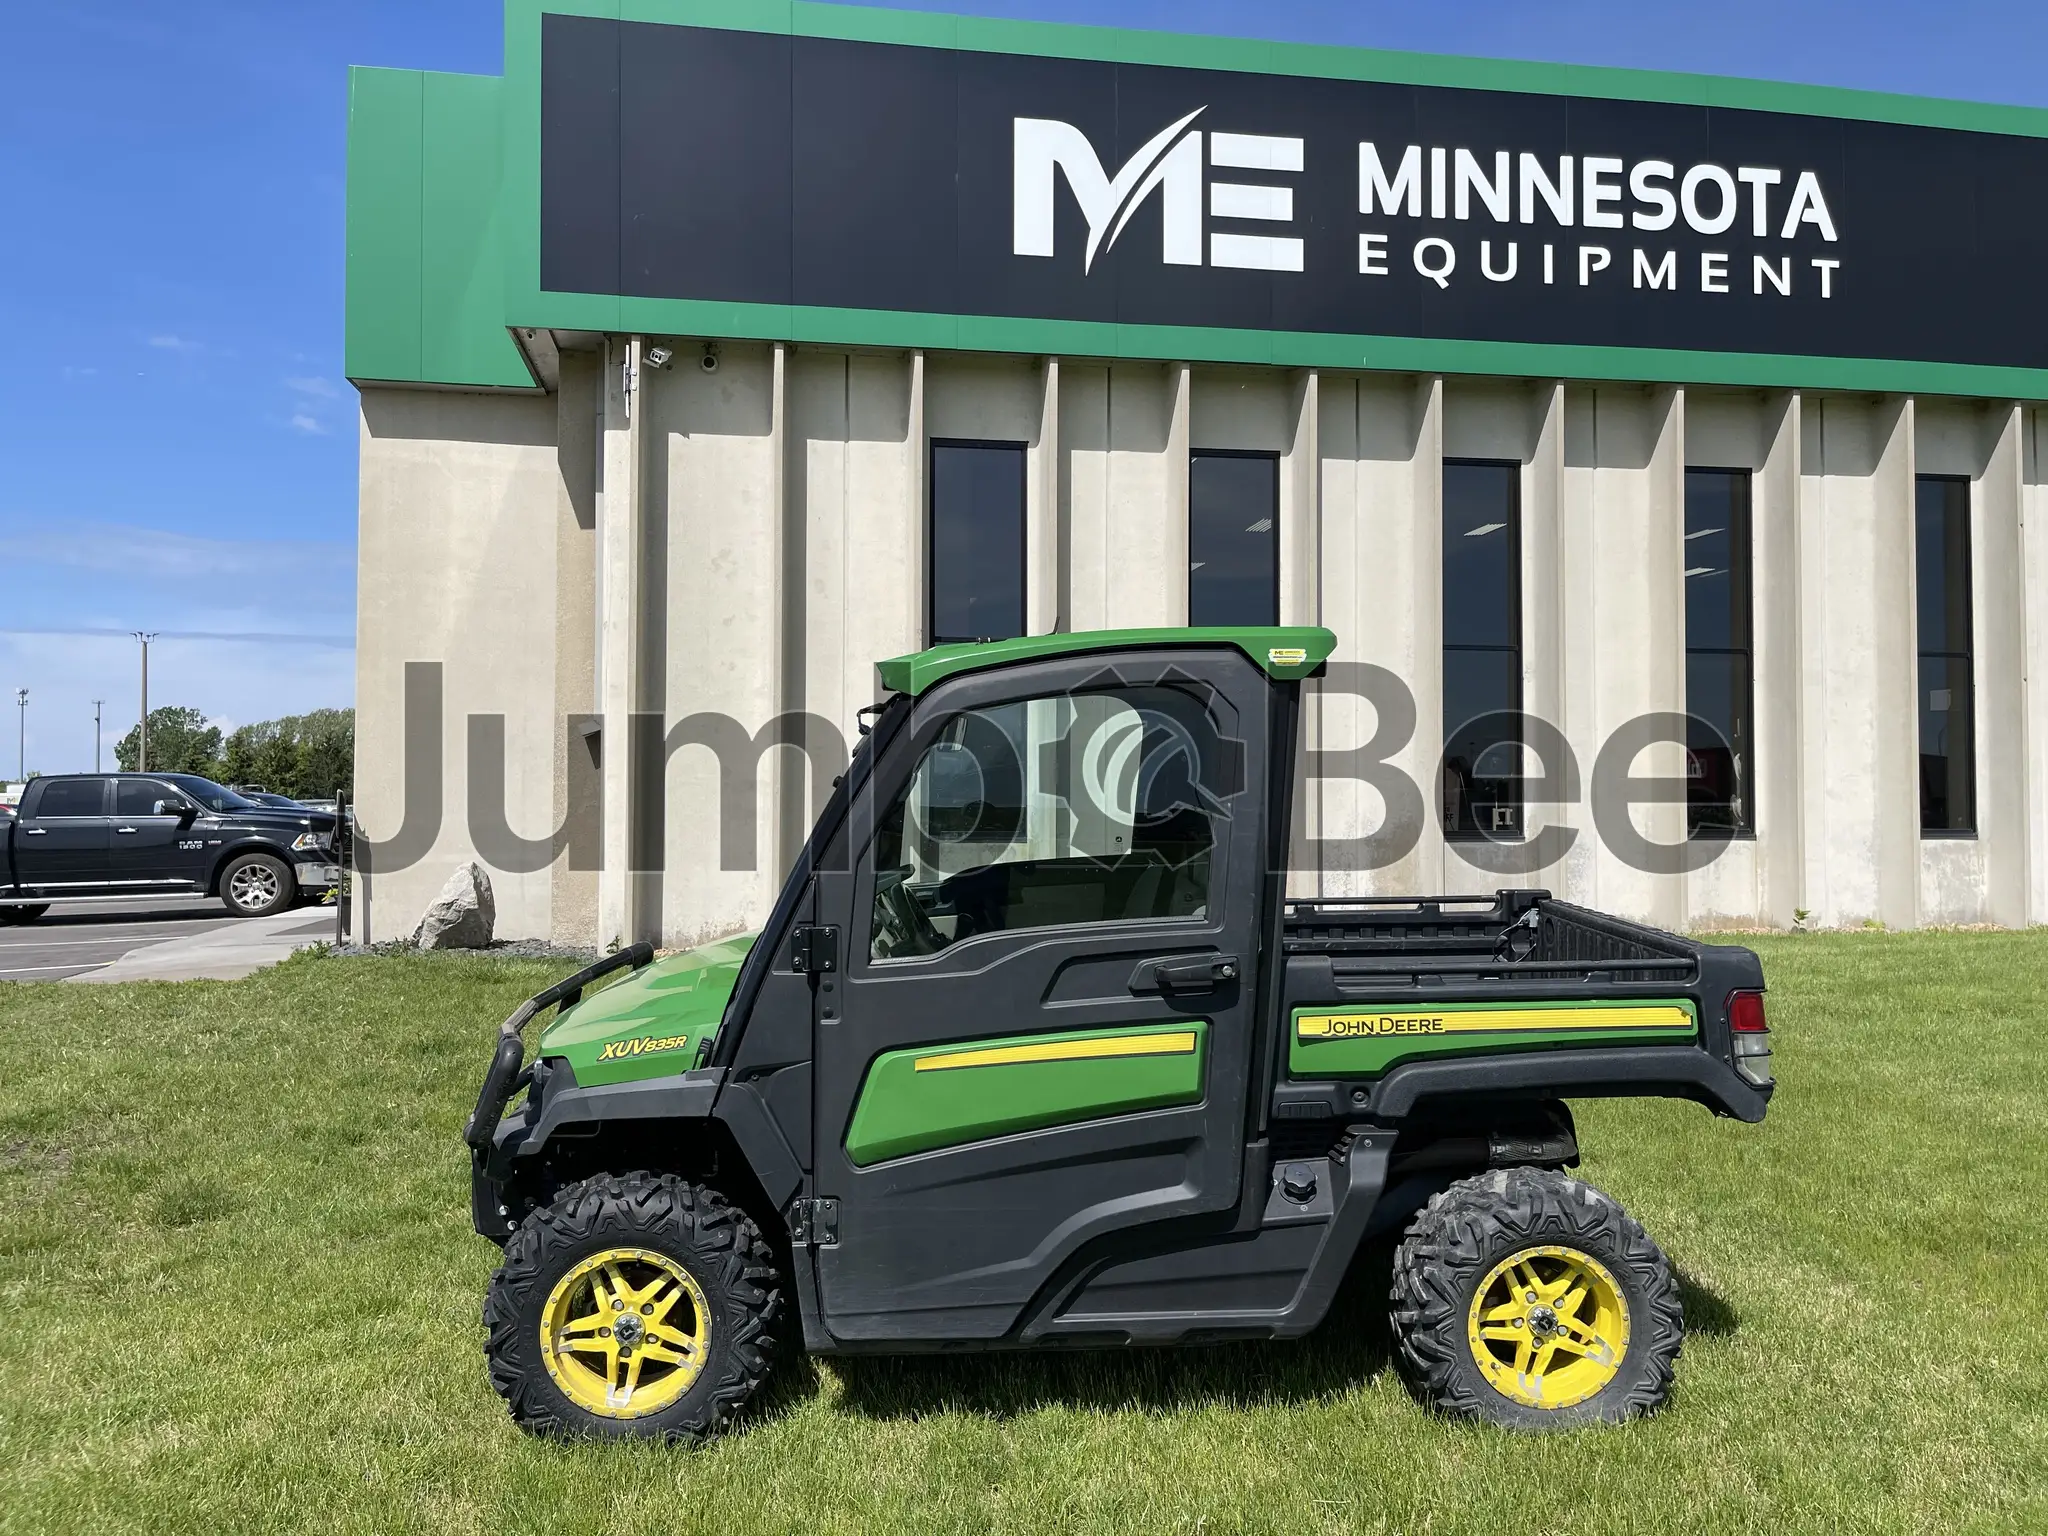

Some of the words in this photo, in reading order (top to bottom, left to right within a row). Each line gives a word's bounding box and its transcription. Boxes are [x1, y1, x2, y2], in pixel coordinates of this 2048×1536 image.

[1013, 104, 1304, 277] ME
[1358, 141, 1839, 243] MINNESOTA
[1358, 233, 1841, 299] EQUIPMENT
[598, 1035, 688, 1062] XUV835R
[1321, 1019, 1374, 1034] JOHN
[1379, 1018, 1443, 1032] DEERE
